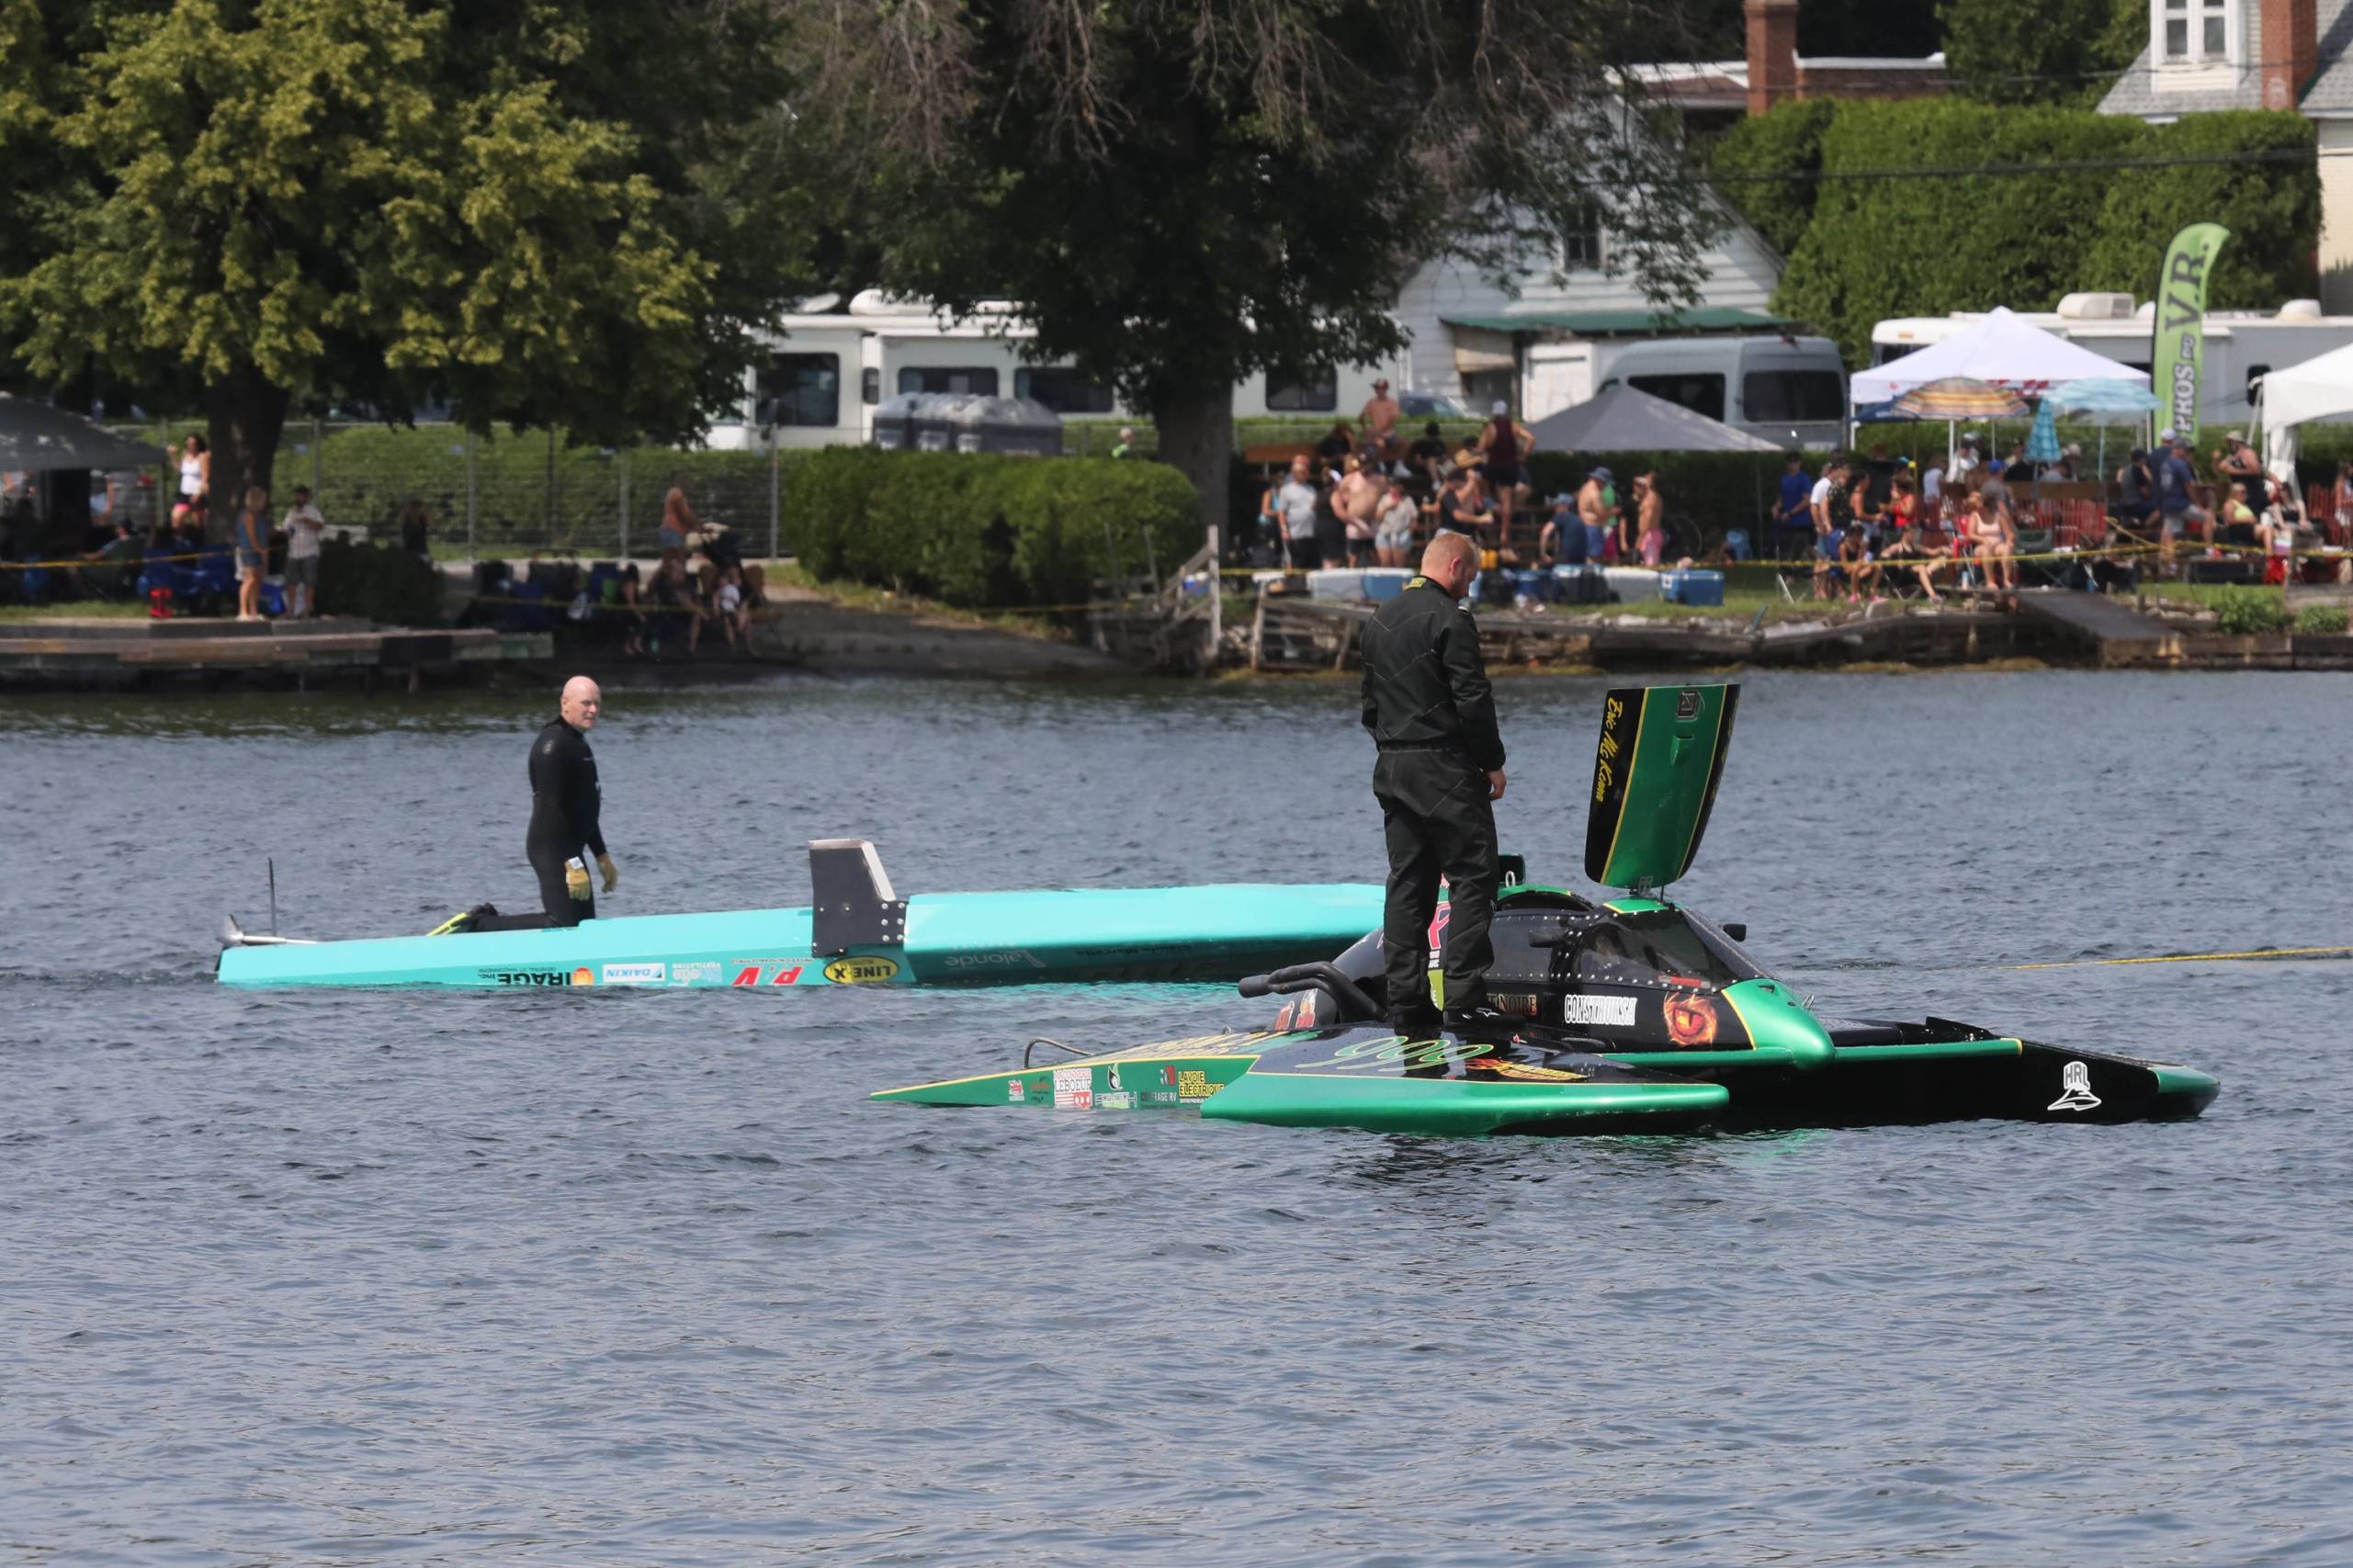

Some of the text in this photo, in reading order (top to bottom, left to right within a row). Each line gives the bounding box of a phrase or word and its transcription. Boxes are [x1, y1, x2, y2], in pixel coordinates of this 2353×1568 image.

[2174, 363, 2196, 434] PROS
[605, 967, 651, 978] DAIKIN
[1178, 1070, 1205, 1083] LAVOIE
[2065, 1061, 2090, 1091] HRL
[1055, 1078, 1092, 1092] LEBOEUF
